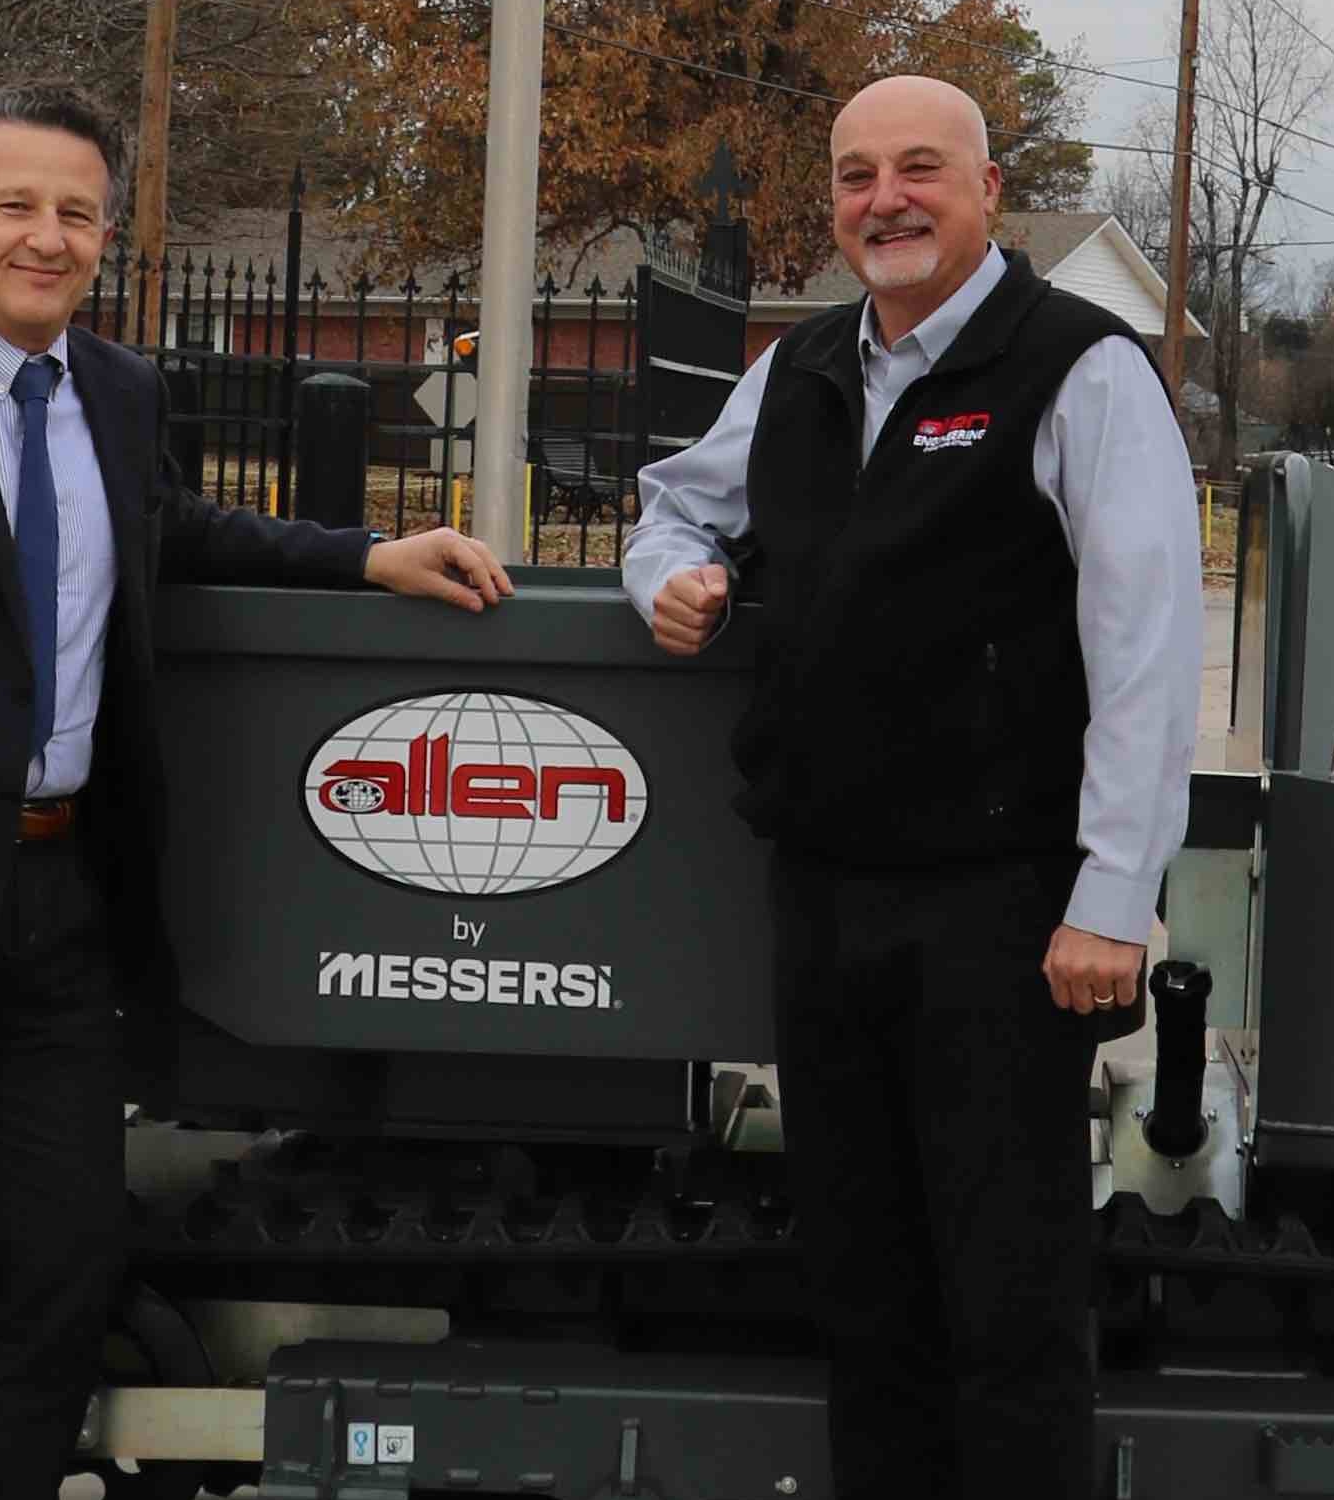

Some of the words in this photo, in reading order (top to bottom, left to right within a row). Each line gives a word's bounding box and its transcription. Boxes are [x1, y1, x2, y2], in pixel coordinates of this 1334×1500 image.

[918, 414, 989, 436] aen
[319, 731, 626, 823] allen
[453, 914, 486, 947] by
